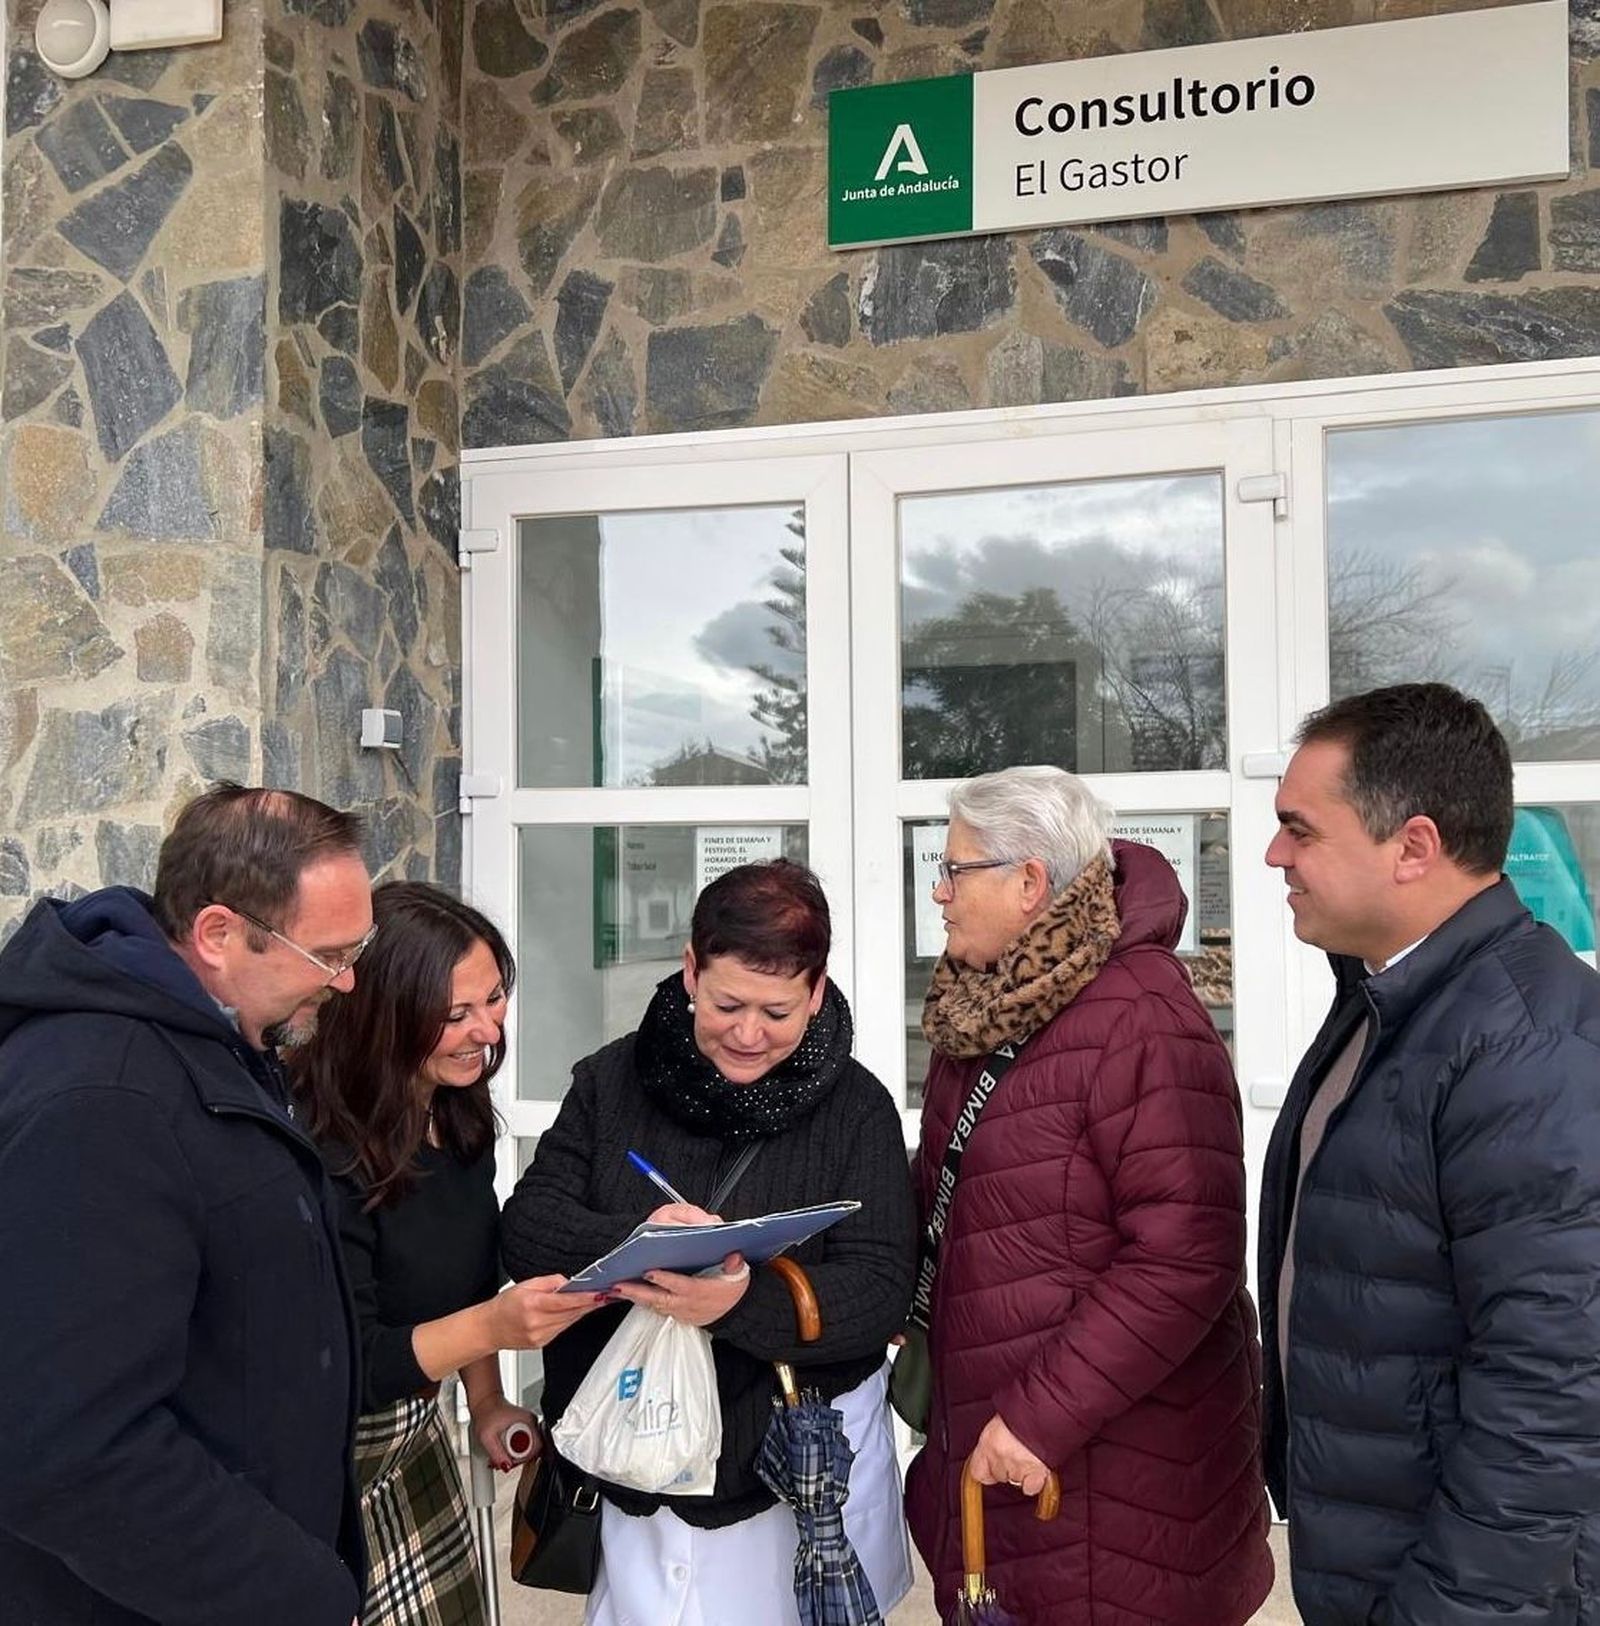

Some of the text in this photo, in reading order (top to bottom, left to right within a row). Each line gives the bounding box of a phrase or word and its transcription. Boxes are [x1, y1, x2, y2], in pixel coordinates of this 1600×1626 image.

[1014, 65, 1316, 138] Consultorio
[841, 175, 960, 202] Junta de Andalucía
[1015, 149, 1189, 197] El Gastor
[736, 836, 766, 844] SEMANA
[1142, 826, 1176, 834] SEMANA
[949, 1069, 997, 1153] BIMBA
